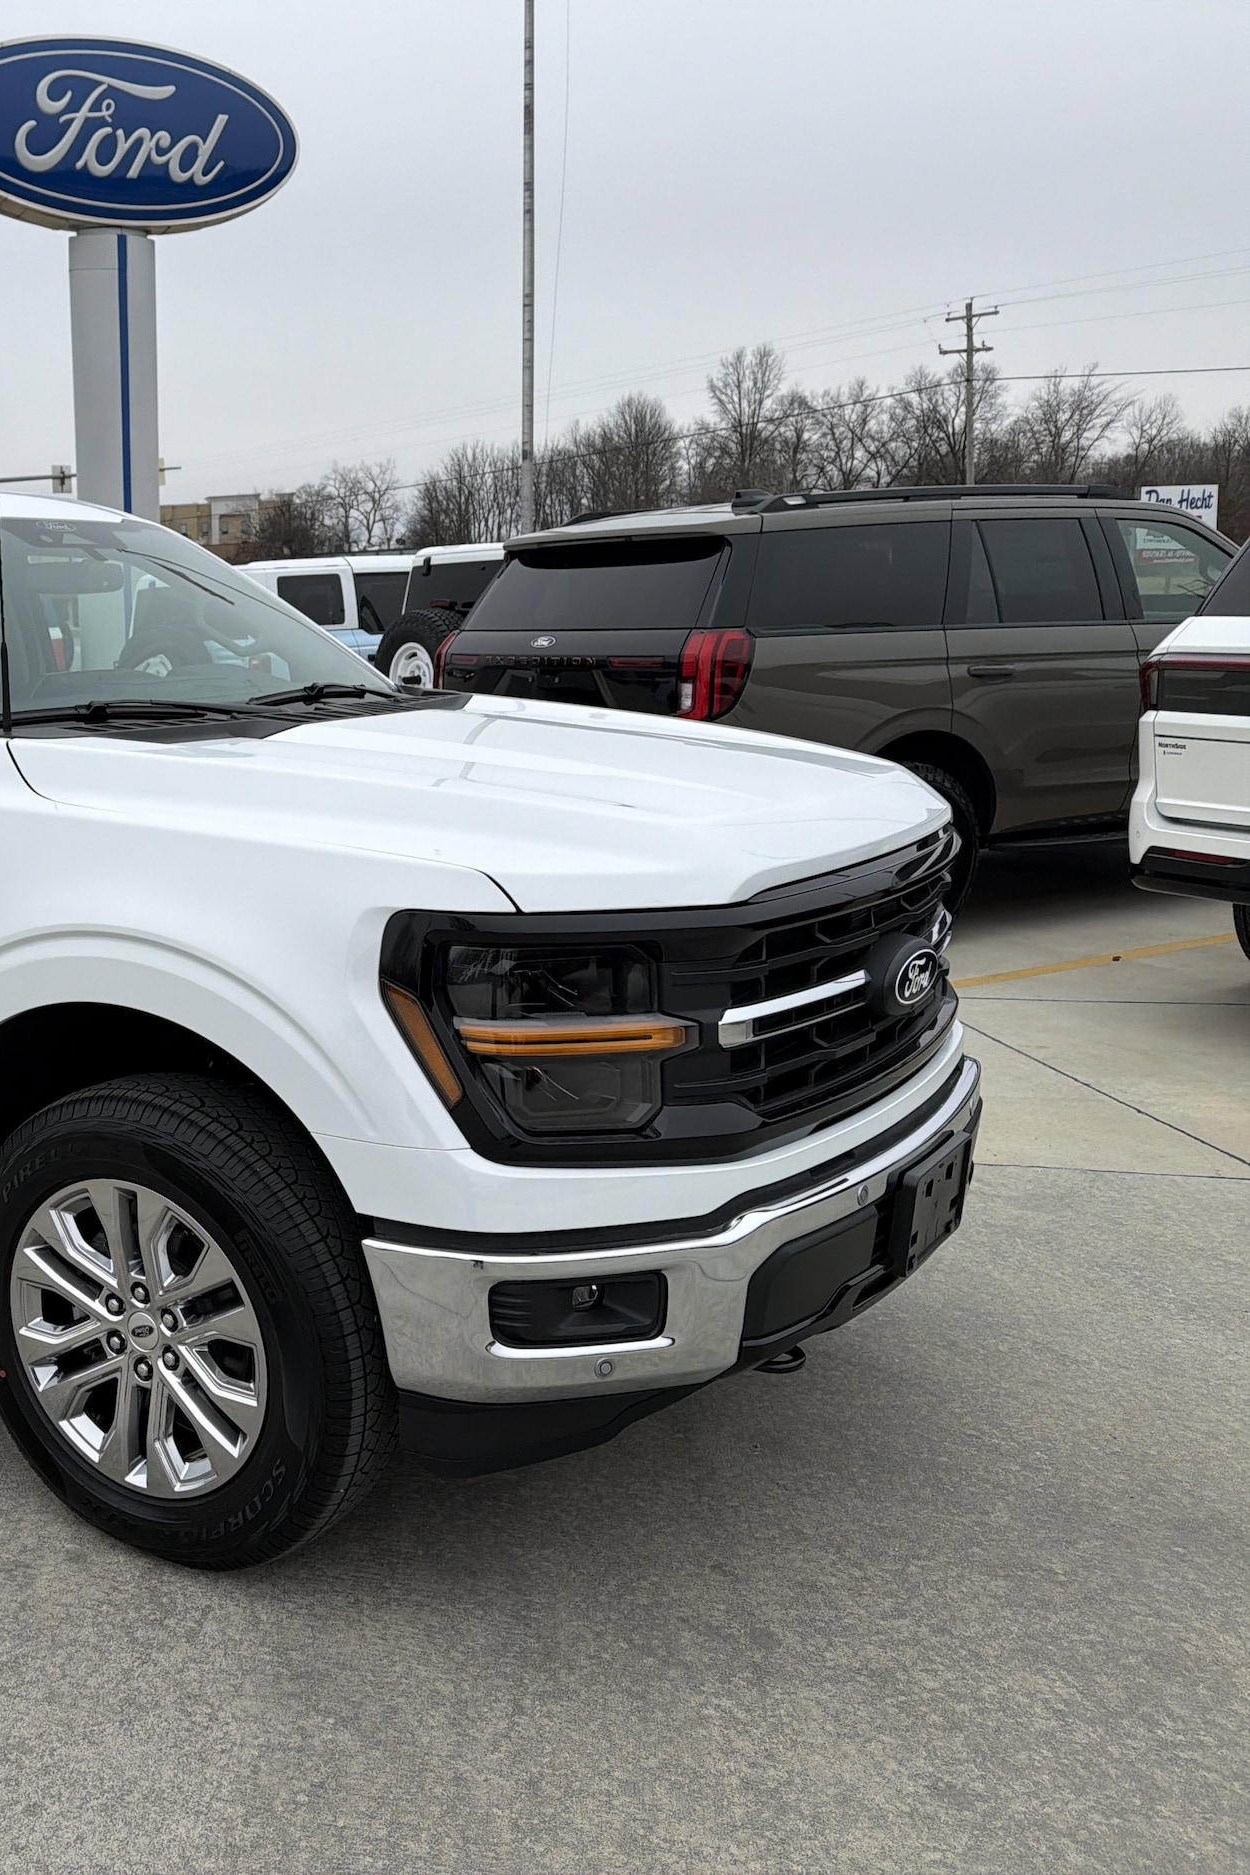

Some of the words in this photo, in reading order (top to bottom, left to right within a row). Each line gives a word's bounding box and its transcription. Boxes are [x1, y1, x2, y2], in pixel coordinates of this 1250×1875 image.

[14, 69, 229, 186] Ford
[1177, 488, 1214, 510] Hecht
[485, 656, 596, 666] EXPEDITION
[904, 957, 933, 998] Ford
